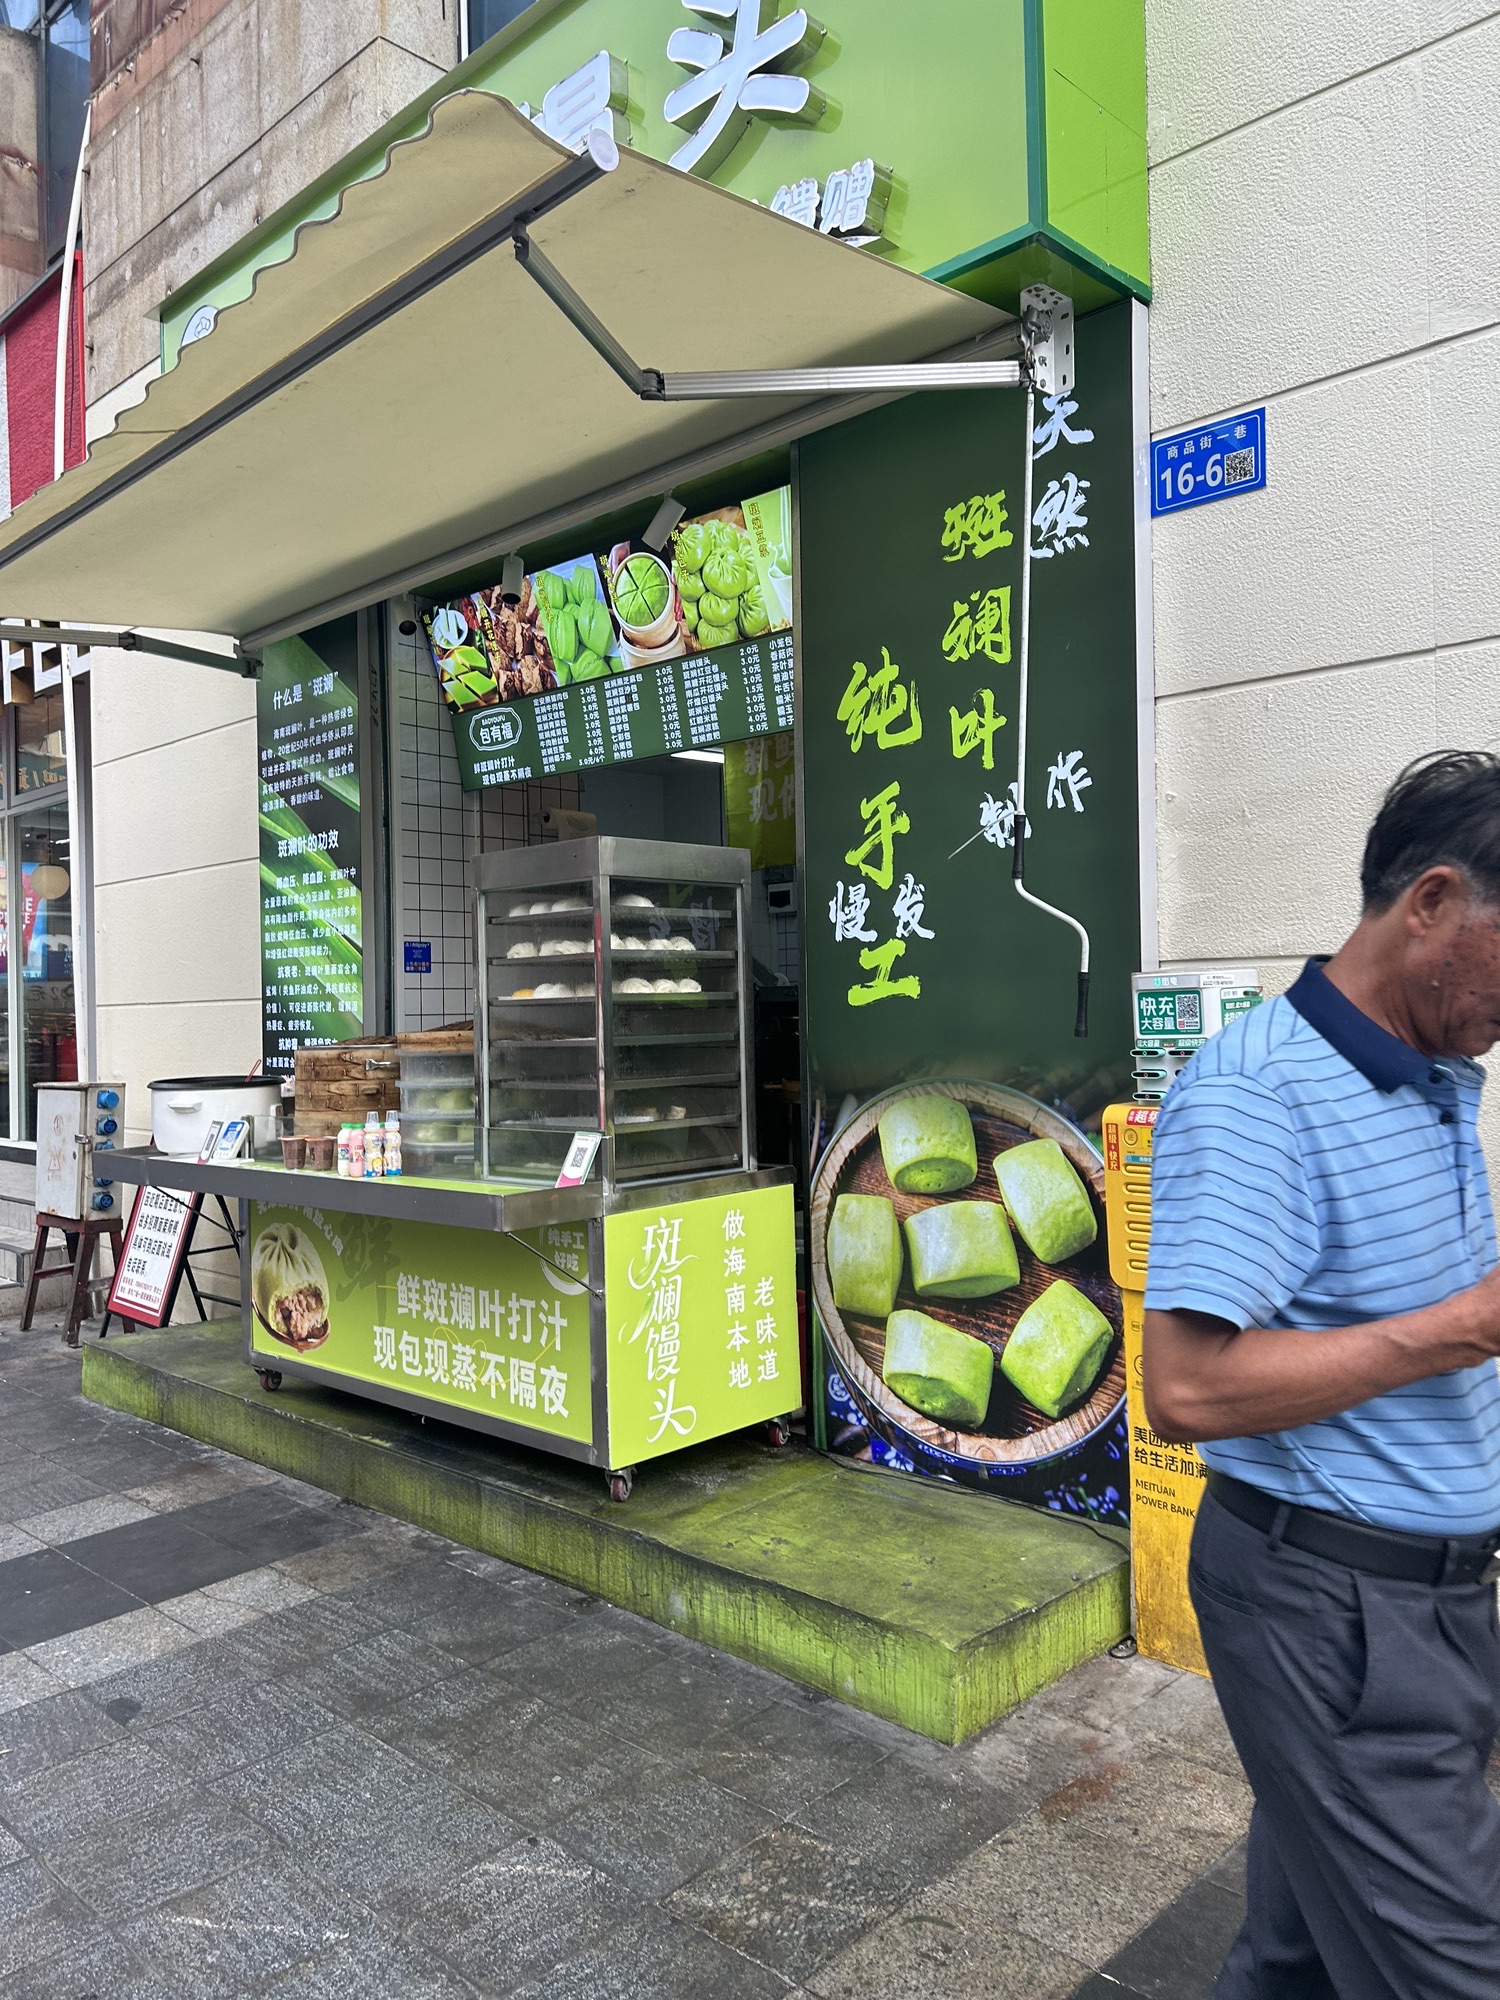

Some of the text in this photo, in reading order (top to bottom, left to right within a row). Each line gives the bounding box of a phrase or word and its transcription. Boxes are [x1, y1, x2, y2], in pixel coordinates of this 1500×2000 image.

[1167, 424, 1247, 460] 商品街一巷
[1161, 453, 1223, 500] 16-6
[941, 489, 1013, 770] 斑斓叶
[769, 636, 792, 650] 小笼包
[740, 644, 758, 656] 2.0元
[741, 654, 760, 665] 3.0元
[656, 666, 672, 676] 3.0元
[742, 664, 761, 675] 3.0元
[657, 675, 674, 685] 3.0元
[743, 674, 762, 684] 3.0元
[580, 685, 596, 695] 3.0元
[658, 684, 675, 694] 3.0元
[746, 683, 763, 694] 1.5元
[774, 682, 794, 693] 牛舌
[581, 694, 597, 704] 3.0元
[659, 694, 676, 704] 3.0元
[746, 694, 764, 704] 3.0元
[776, 693, 794, 705] 糯米
[583, 702, 598, 712] 3.0元
[661, 703, 677, 713] 3.0元
[747, 703, 766, 713] 3.0元
[584, 711, 599, 720] 3.0元
[662, 712, 679, 722] 3.0元
[749, 712, 767, 722] 4.0元
[585, 720, 600, 729] 3.0元
[663, 721, 680, 731] 3.0元
[750, 722, 768, 732] 5.0元
[480, 721, 513, 745] 包有福
[587, 728, 602, 738] 3.0元
[664, 730, 681, 740] 3.0元
[588, 737, 603, 746] 3.0元
[666, 739, 682, 749] 3.0元
[836, 645, 922, 1007] 纯手工
[278, 829, 339, 859] 斑斓叶的功效
[829, 872, 936, 942] 慢发
[1140, 996, 1175, 1017] 快充
[1140, 1017, 1175, 1031] 大容量
[547, 1228, 585, 1250] 纯手工
[722, 1208, 752, 1389] 做海南本地
[396, 1272, 568, 1352] 鲜斑斓叶打汁
[753, 1275, 780, 1383] 老味道
[373, 1324, 570, 1419] 现包现蒸不隔夜
[1134, 1446, 1208, 1479] 给生活加满
[1135, 1478, 1176, 1497] MEITUAN
[1135, 1493, 1196, 1519] POWER BANK
